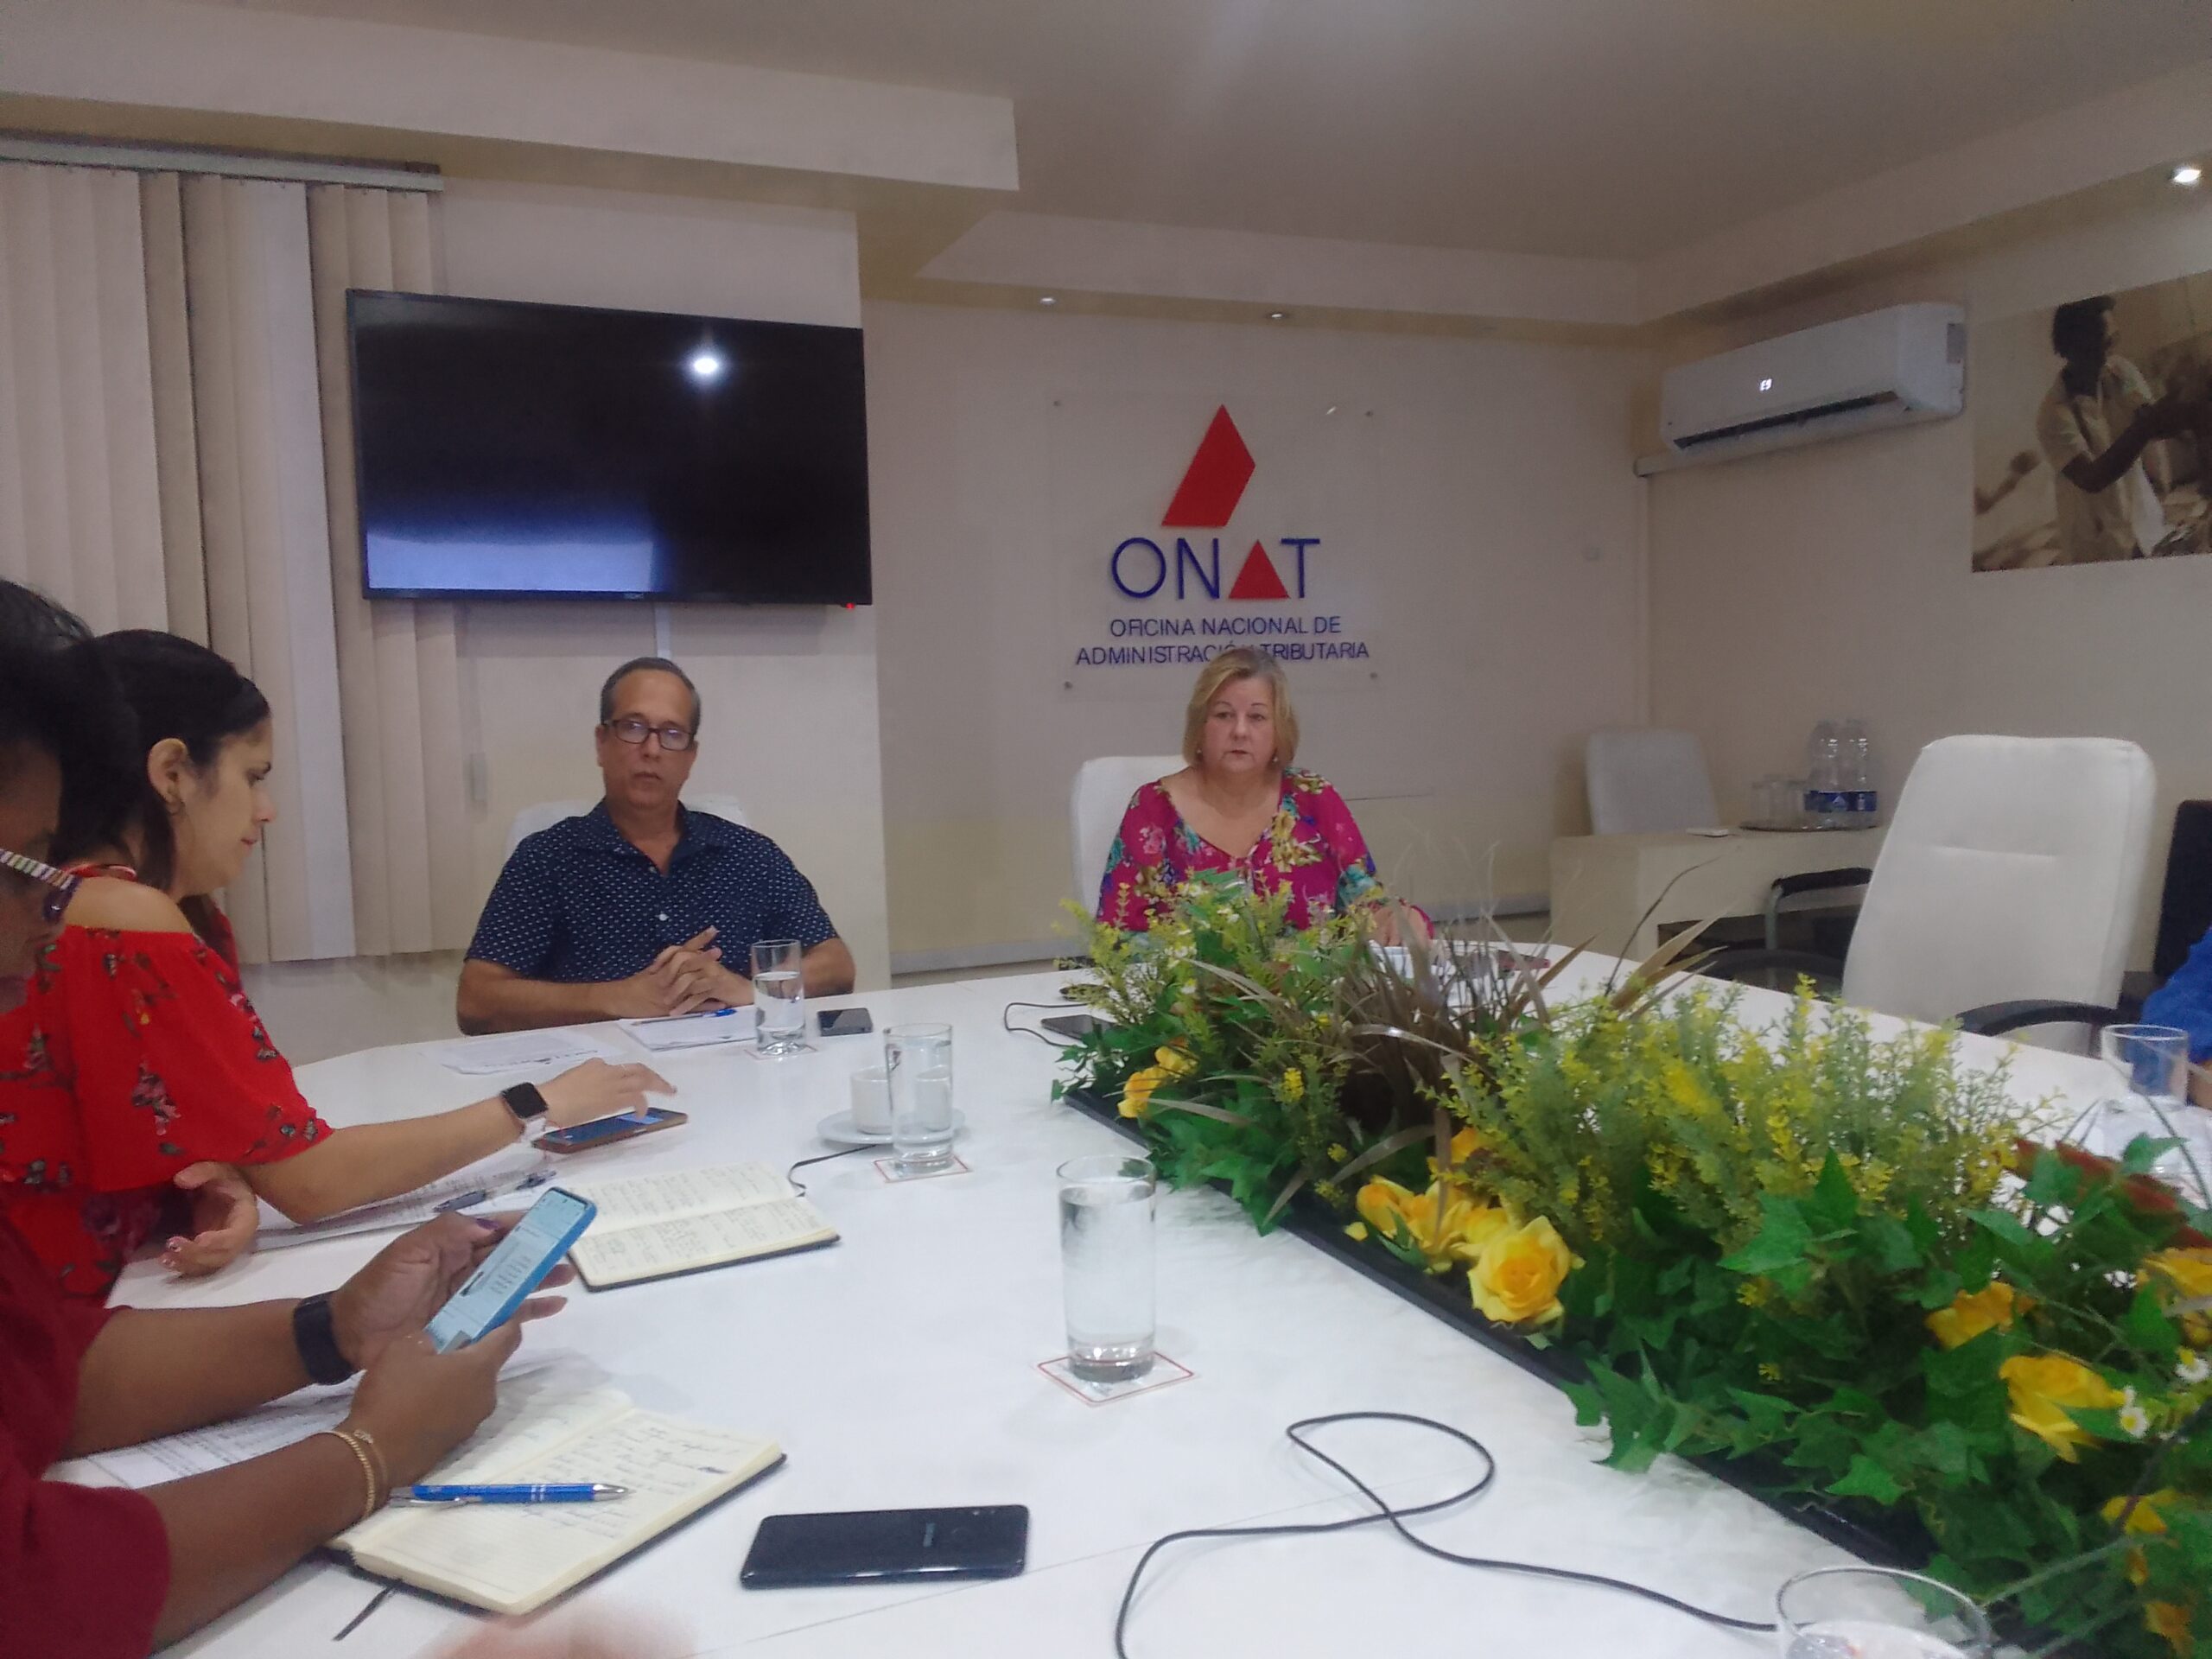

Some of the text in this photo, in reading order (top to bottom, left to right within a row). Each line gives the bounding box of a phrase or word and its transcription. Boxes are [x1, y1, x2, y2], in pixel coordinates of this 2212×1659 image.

[1111, 537, 1320, 600] ONAT
[1110, 616, 1341, 637] OFICINA NACIONAL DE
[1077, 640, 1369, 664] ADMINISTRAC TRIBUTARIA
